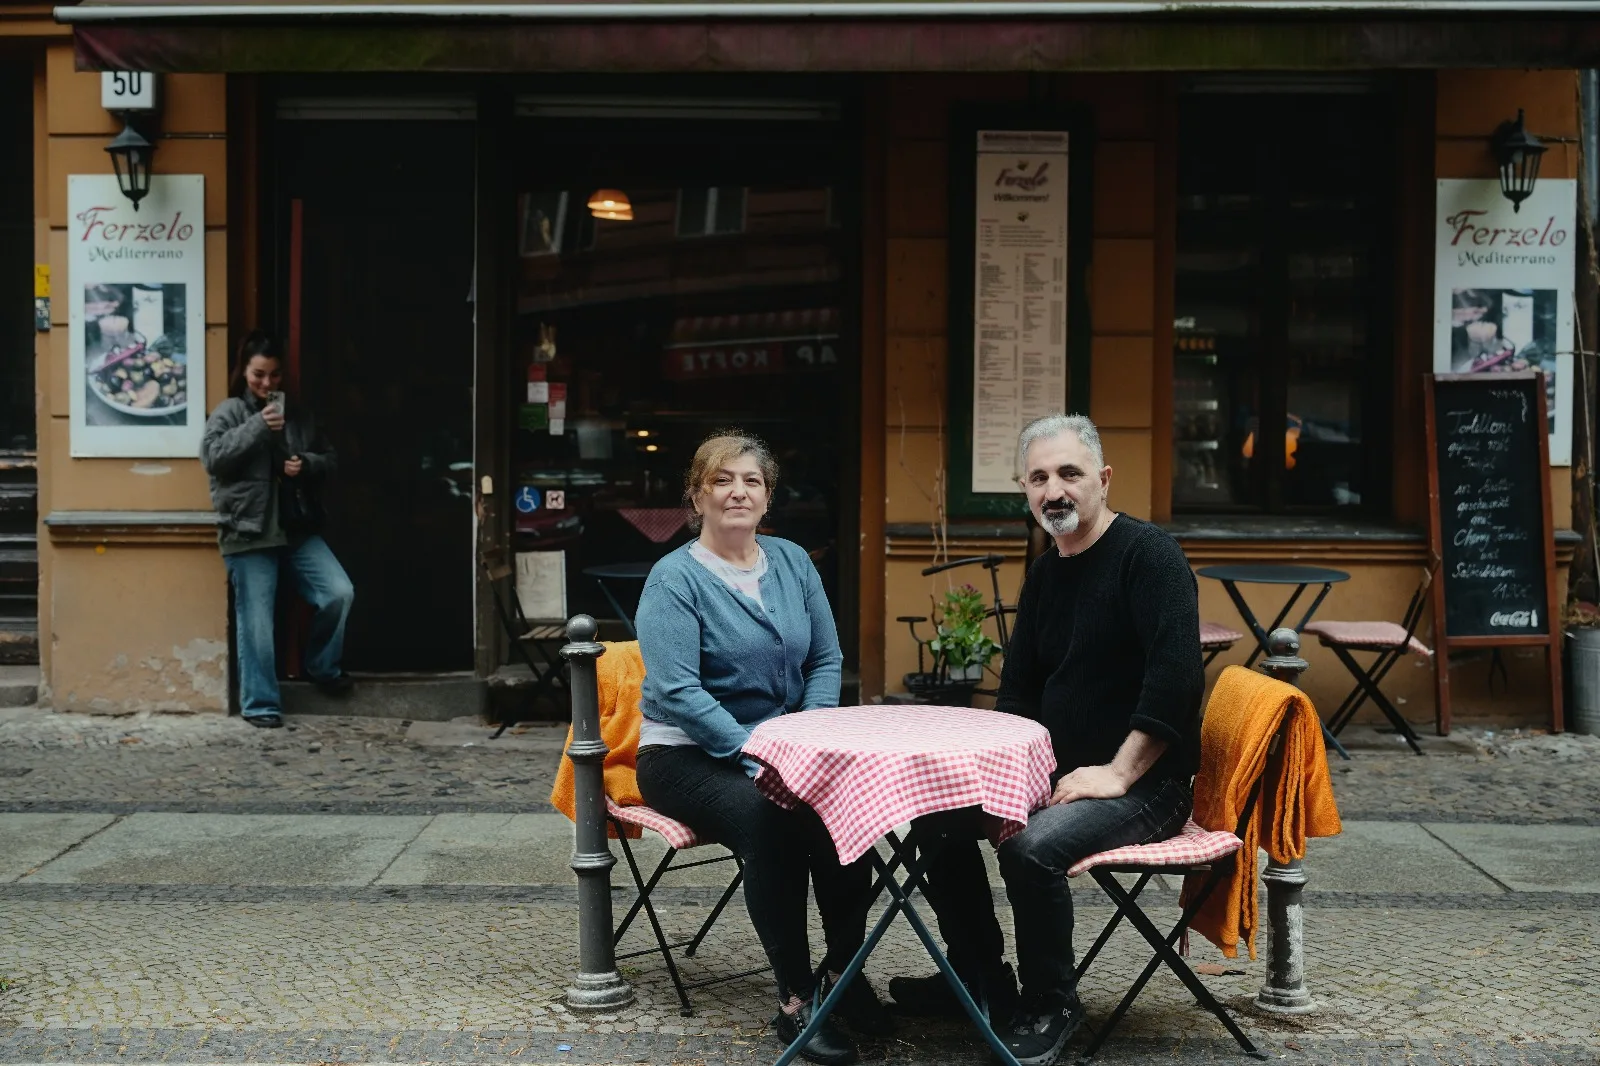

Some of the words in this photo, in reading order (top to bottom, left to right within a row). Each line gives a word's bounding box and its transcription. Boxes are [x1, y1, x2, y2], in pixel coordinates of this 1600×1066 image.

[112, 71, 142, 95] 50
[76, 206, 194, 241] Ferzelo
[1446, 209, 1567, 247] Ferzelo
[89, 246, 184, 262] Mediterrano
[1458, 250, 1556, 267] Mediterrano
